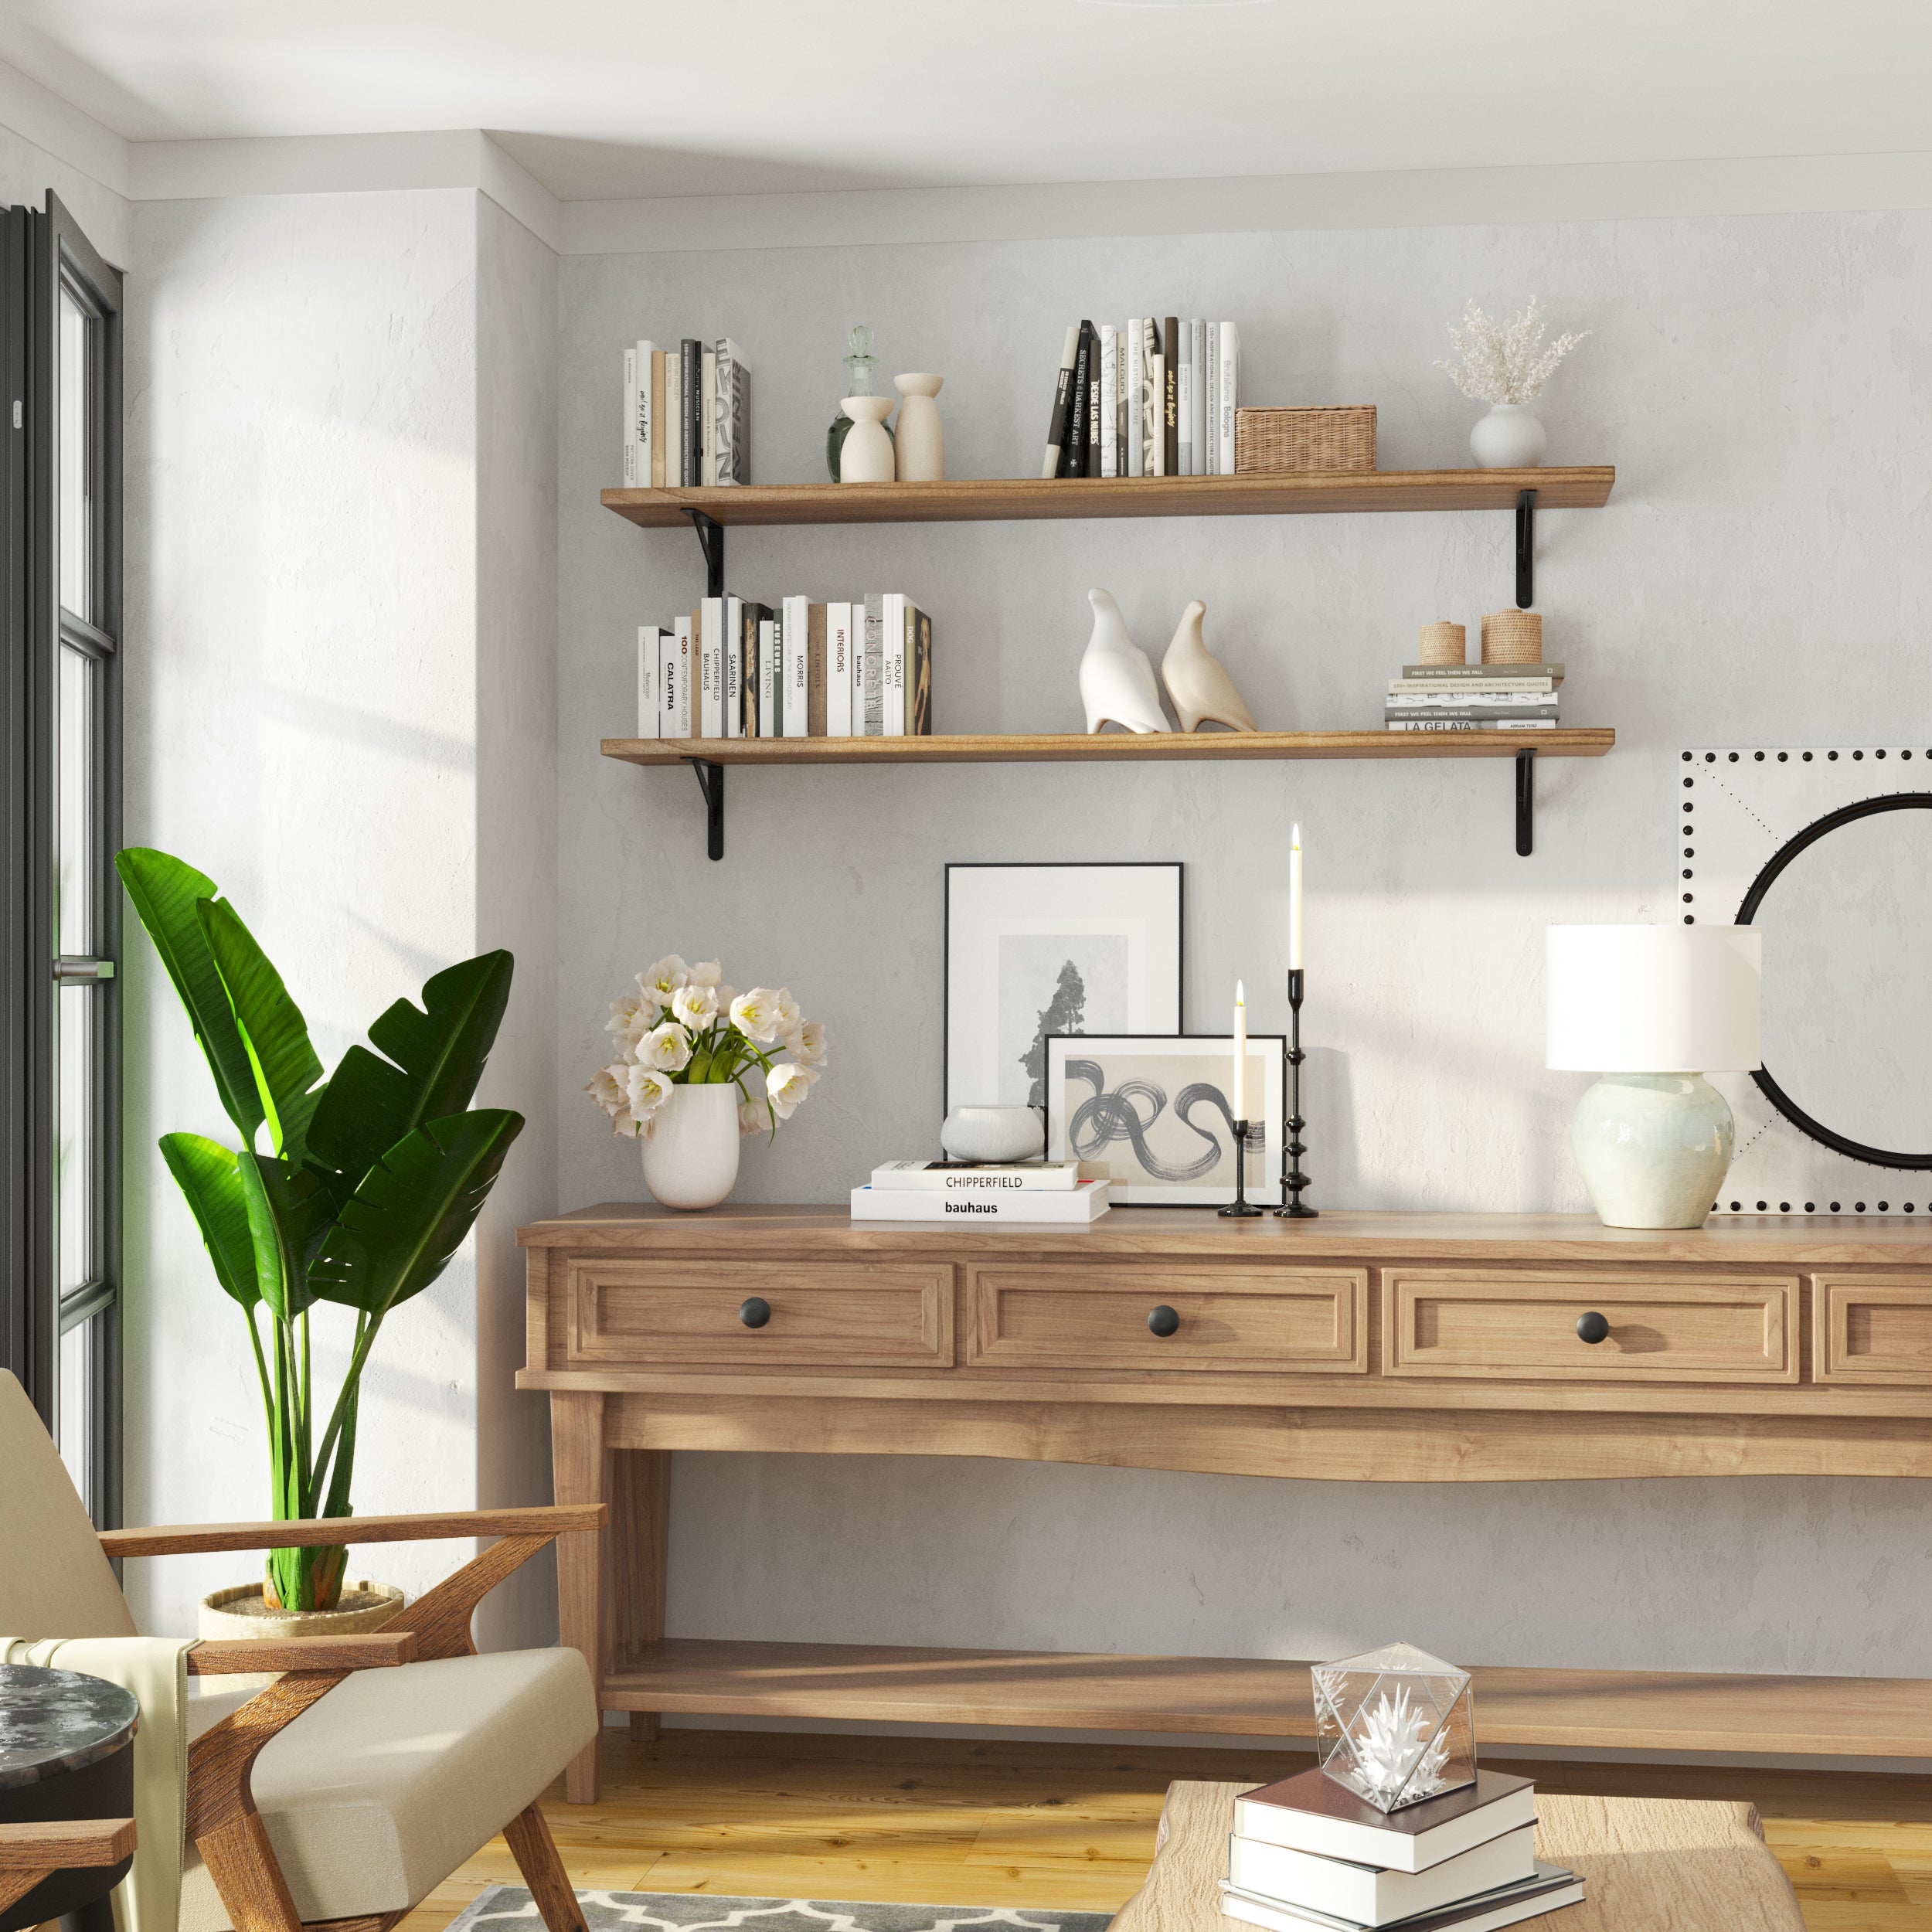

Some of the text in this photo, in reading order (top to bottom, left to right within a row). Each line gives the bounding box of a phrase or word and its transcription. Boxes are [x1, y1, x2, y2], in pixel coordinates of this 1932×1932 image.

[1077, 349, 1087, 384] SECRETS
[1073, 391, 1083, 427] DARKEST
[1090, 406, 1099, 420] LAS
[1133, 394, 1138, 405] OF
[1223, 406, 1231, 437] Bologna
[866, 617, 877, 709] CONCRETE
[894, 655, 903, 689] PROUVÉ
[946, 1177, 1022, 1188] CHIPPERFIELD
[945, 1202, 998, 1213] bauhaus
